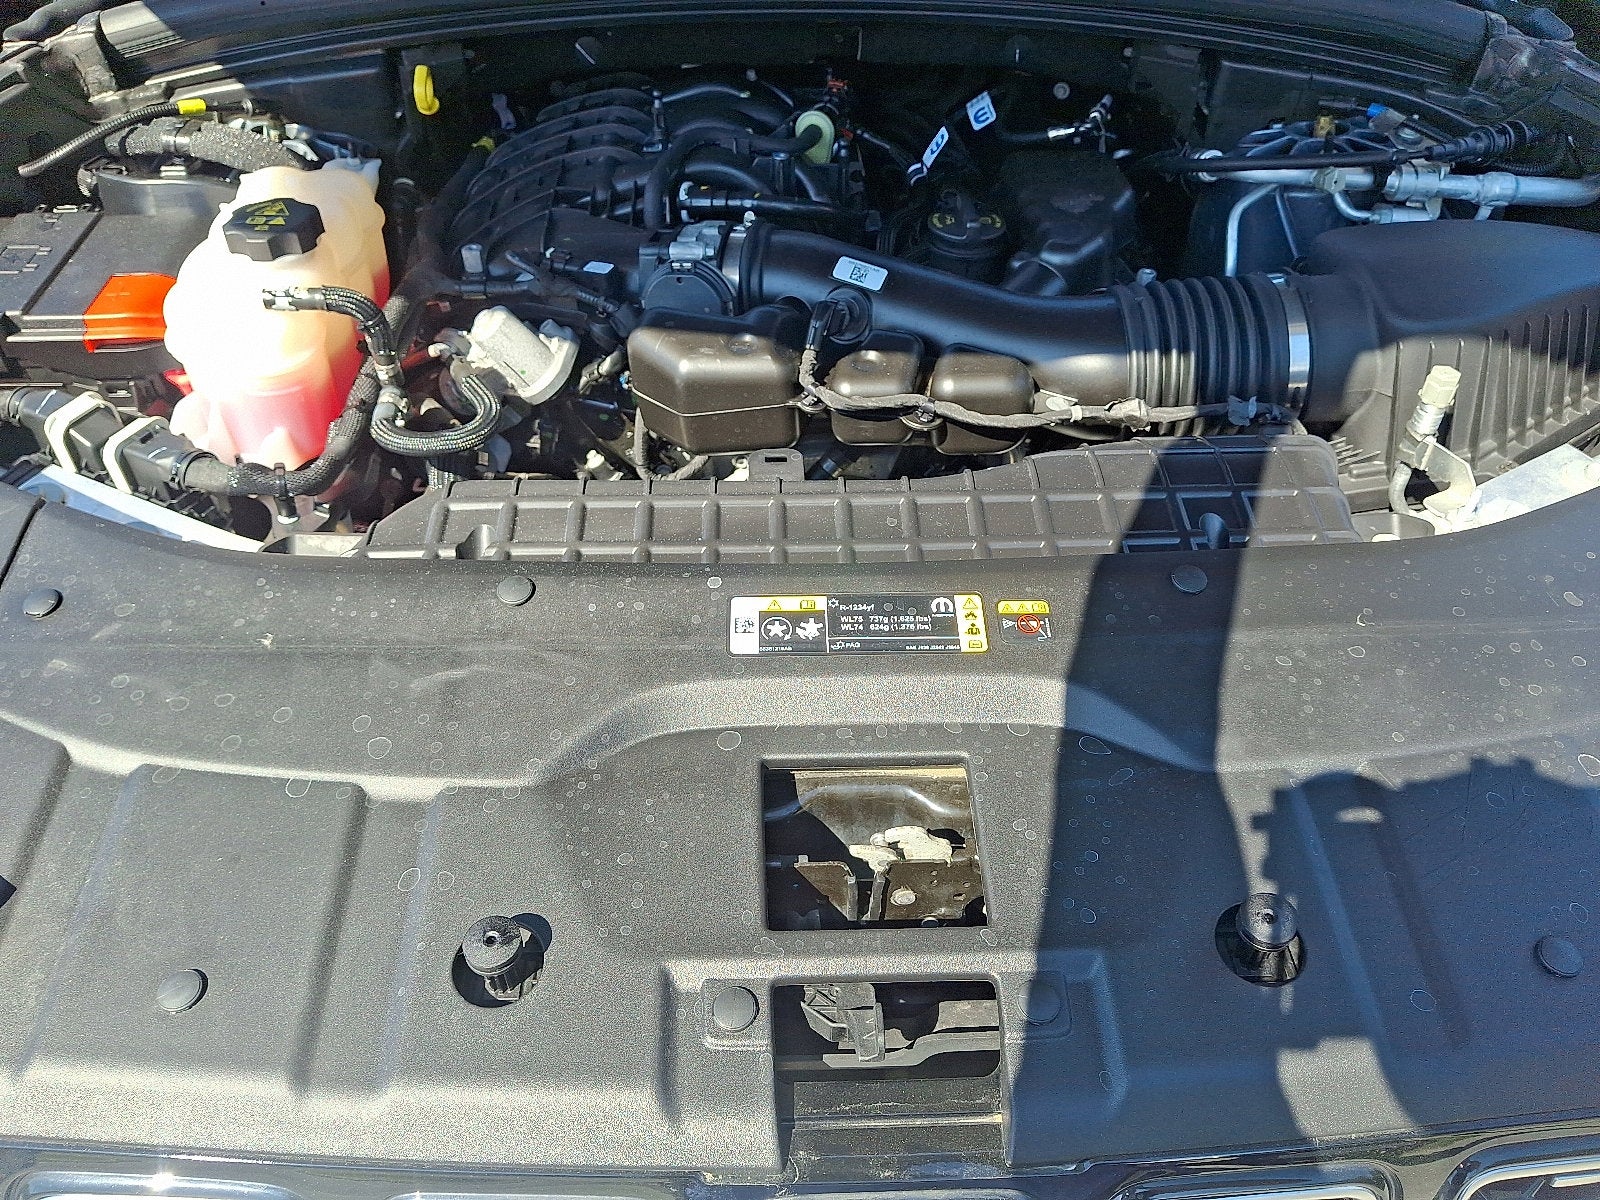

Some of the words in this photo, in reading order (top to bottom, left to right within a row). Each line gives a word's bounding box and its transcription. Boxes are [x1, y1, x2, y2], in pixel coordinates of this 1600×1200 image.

[840, 615, 864, 623] WL75
[869, 615, 889, 624] 737g
[840, 623, 864, 631] WL74
[869, 623, 889, 632] 624g
